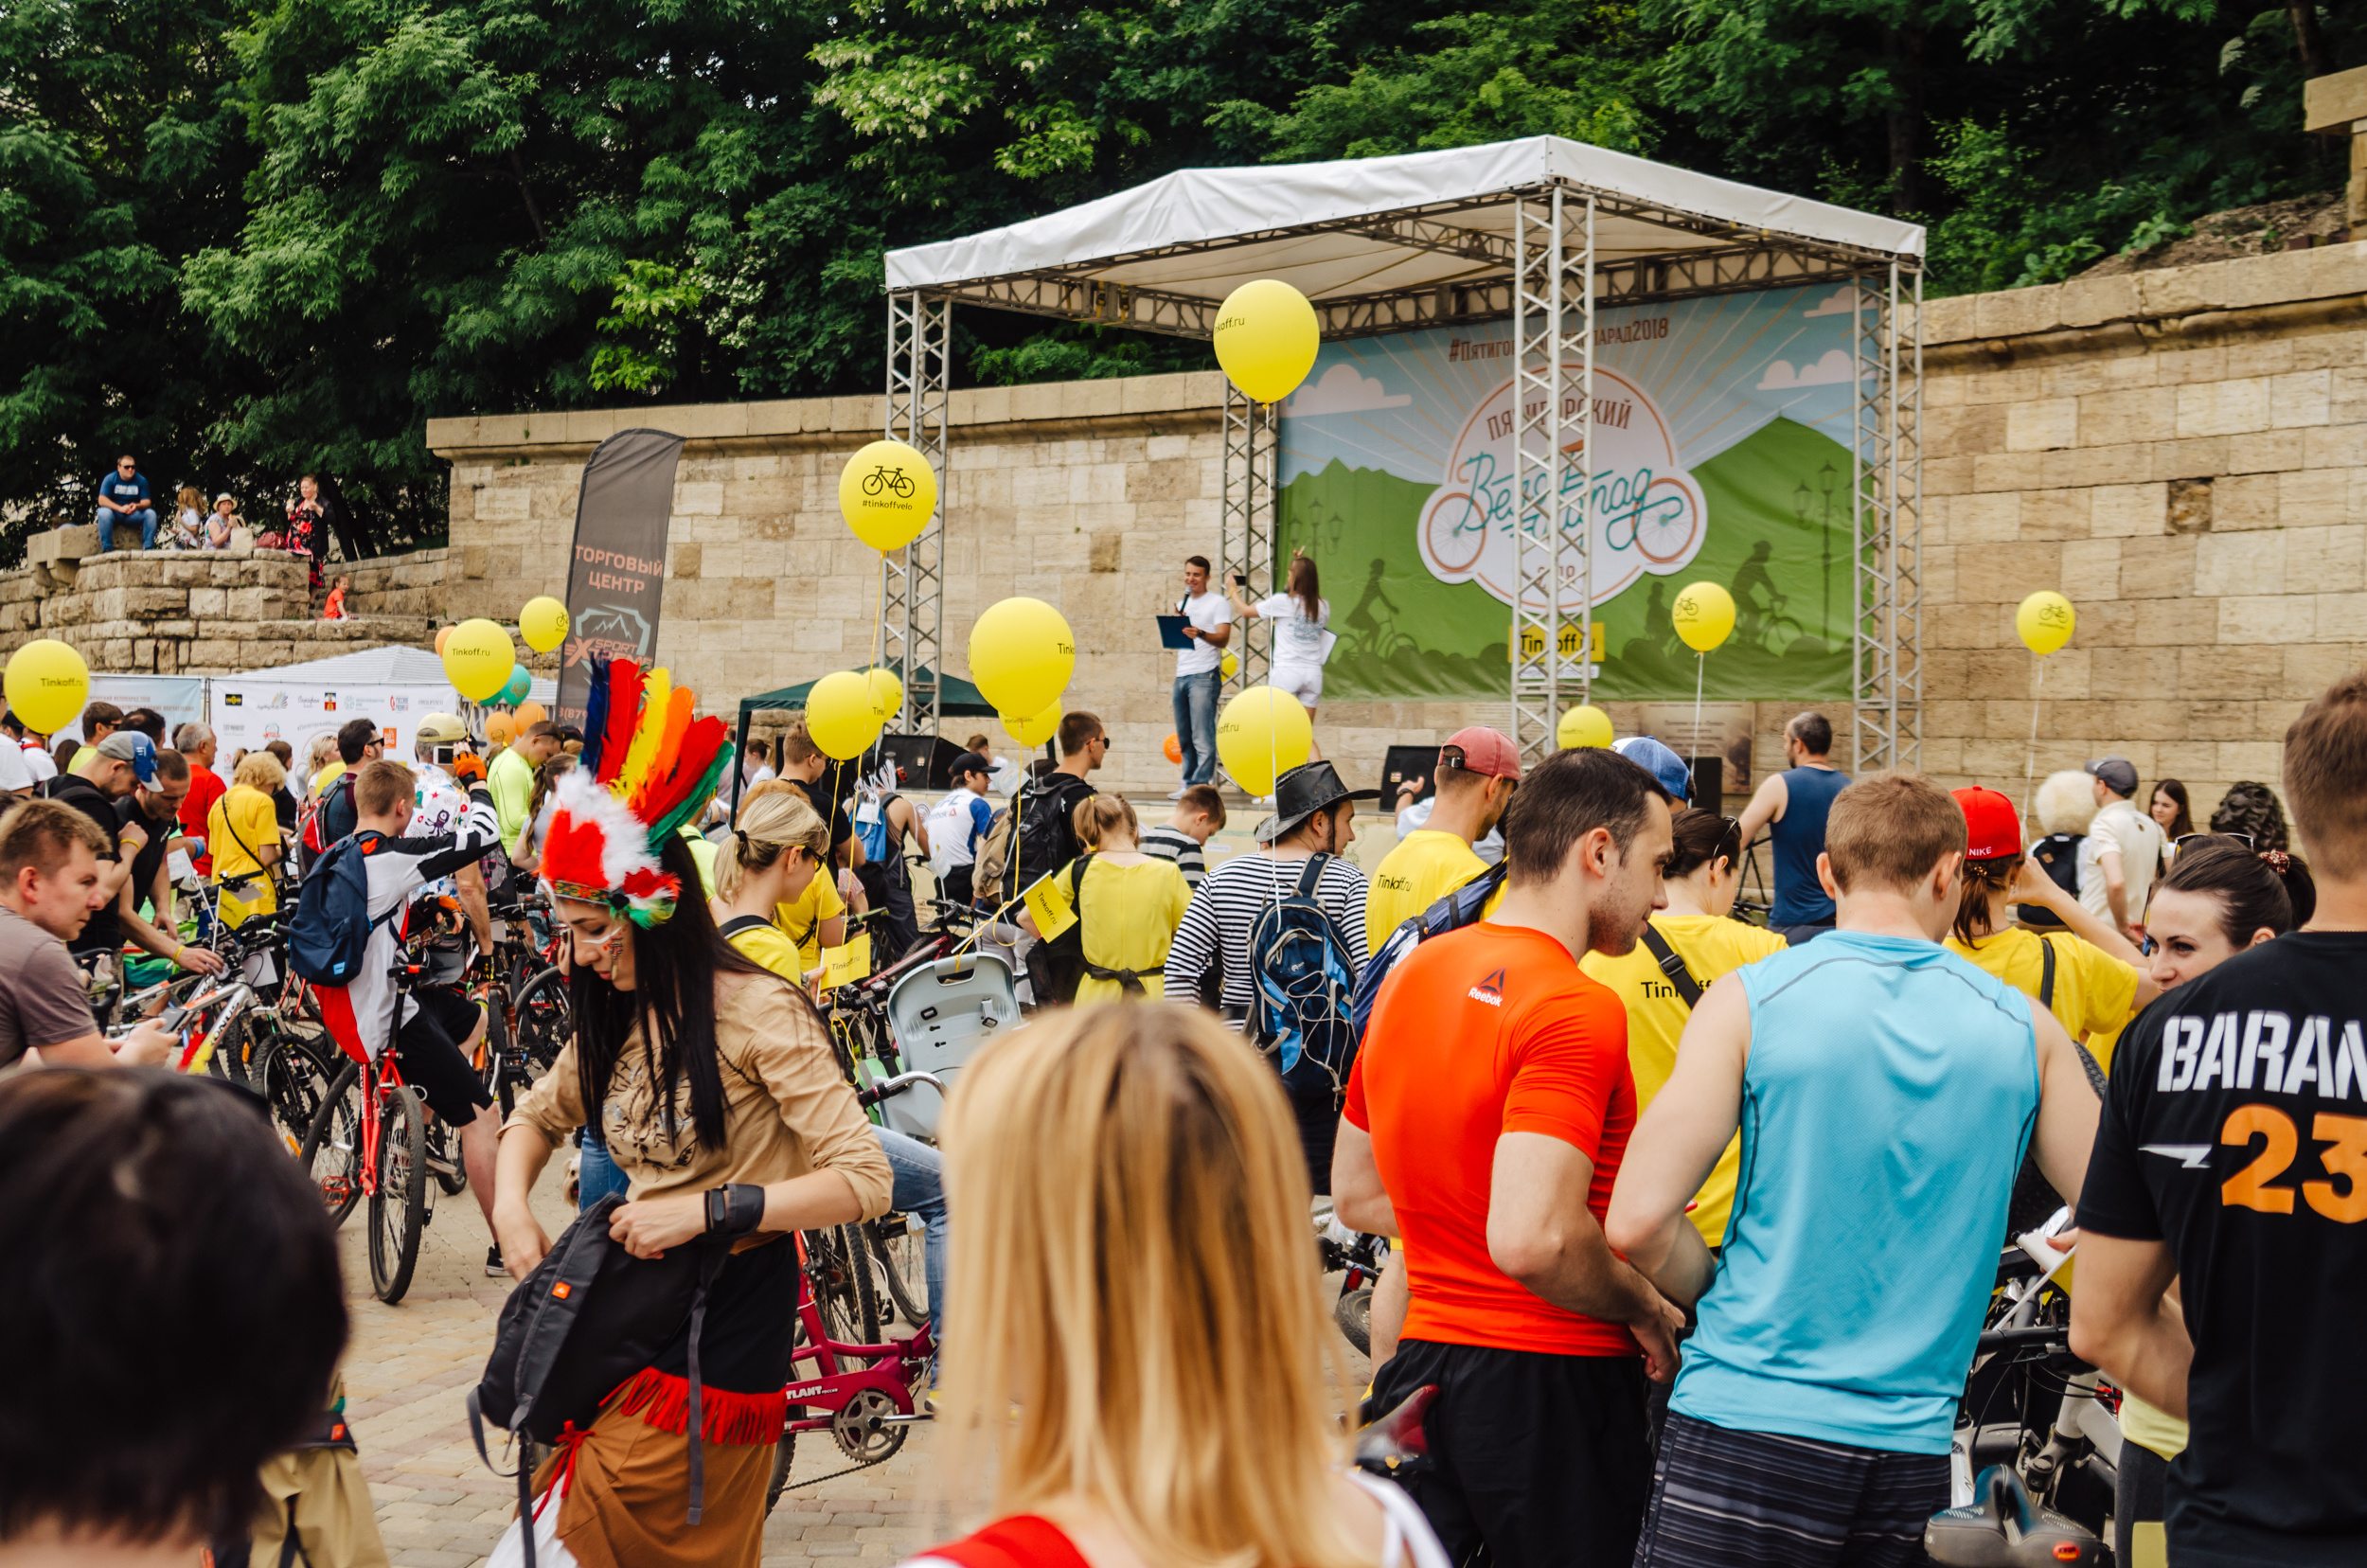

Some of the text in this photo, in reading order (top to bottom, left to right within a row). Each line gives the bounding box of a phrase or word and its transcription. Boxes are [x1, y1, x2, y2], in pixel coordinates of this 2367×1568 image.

[862, 499, 913, 510] #tinkoffvelo
[575, 544, 664, 578] ТОРГОВЫЙ
[588, 571, 645, 595] ЦЕНТР
[453, 648, 490, 656] Tinkoff.ru
[595, 638, 638, 653] SPORT
[40, 677, 83, 687] Tinkoff.ru
[1968, 846, 1992, 857] NIKE
[1038, 892, 1058, 925] Tinkoff.ru
[1468, 986, 1504, 1007] Reebok
[2220, 1102, 2367, 1224] 23
